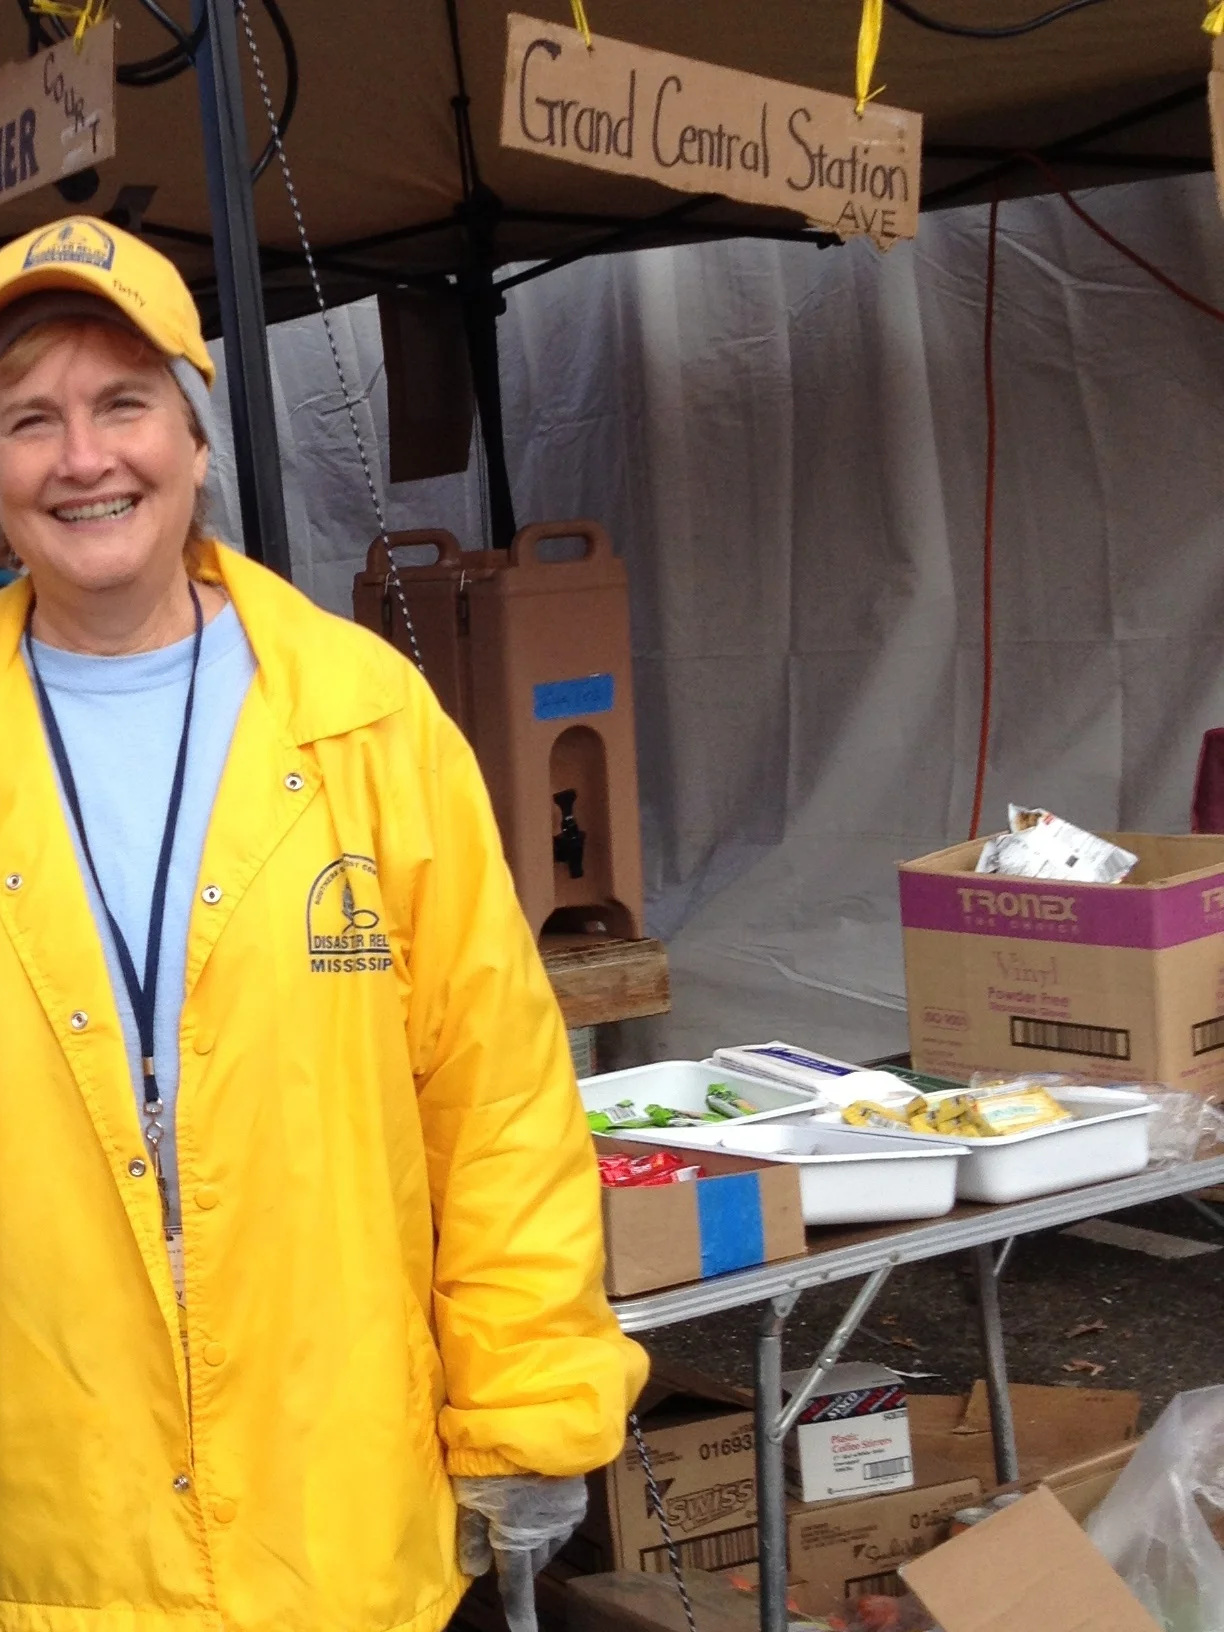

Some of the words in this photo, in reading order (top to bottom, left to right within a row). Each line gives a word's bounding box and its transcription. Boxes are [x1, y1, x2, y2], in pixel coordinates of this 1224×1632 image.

[520, 38, 636, 159] Grand
[652, 75, 769, 179] Central
[786, 107, 910, 202] Station
[836, 200, 897, 237] AVE
[957, 887, 1078, 921] TRONEX
[313, 934, 364, 949] DISASTR
[369, 934, 390, 947] REL
[311, 957, 393, 973] MISSSSIP
[992, 951, 1057, 988] Vinyl
[666, 1478, 755, 1528] SWISS
